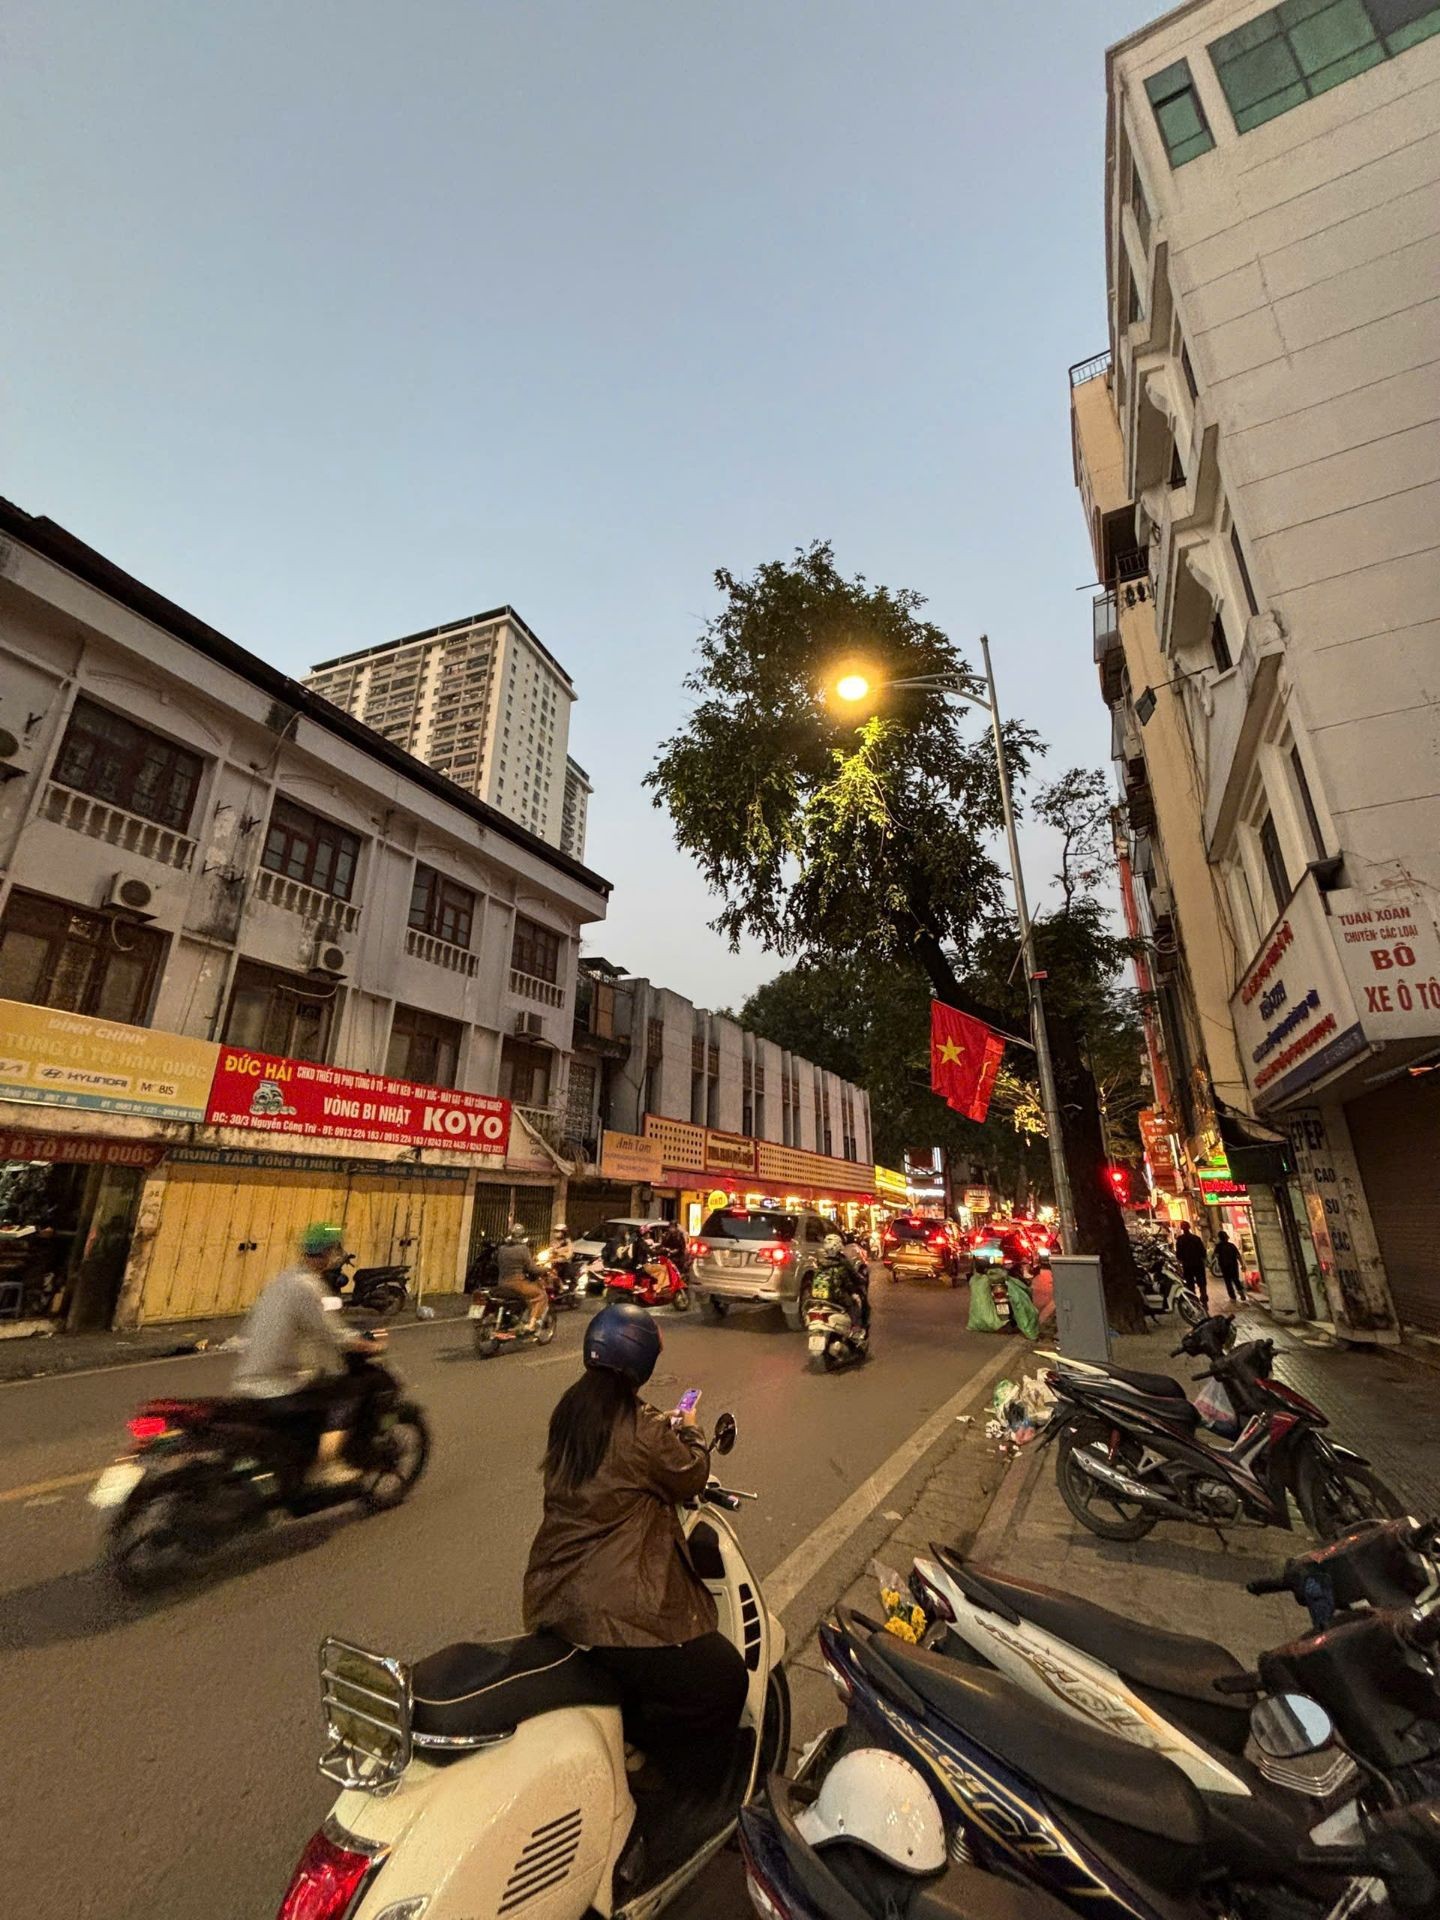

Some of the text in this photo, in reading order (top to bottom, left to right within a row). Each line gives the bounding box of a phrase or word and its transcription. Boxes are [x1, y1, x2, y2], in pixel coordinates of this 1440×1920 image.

[1363, 976, 1440, 1013] XE Ô TÔ
[224, 1053, 293, 1082] ĐỨC HẢI
[316, 1067, 334, 1084] THIẾT
[67, 1071, 128, 1089] HYUNDAI
[140, 1081, 174, 1096] MBIS
[323, 1095, 412, 1127] VÒNG BI NHẬT
[283, 1120, 303, 1133] Công
[334, 1127, 352, 1137] 0913
[352, 1129, 365, 1139] 224
[383, 1132, 400, 1142] 0915
[400, 1134, 411, 1143] 224
[423, 1106, 503, 1139] KOYO
[1314, 1168, 1336, 1183] CAO
[1325, 1198, 1340, 1214] SU
